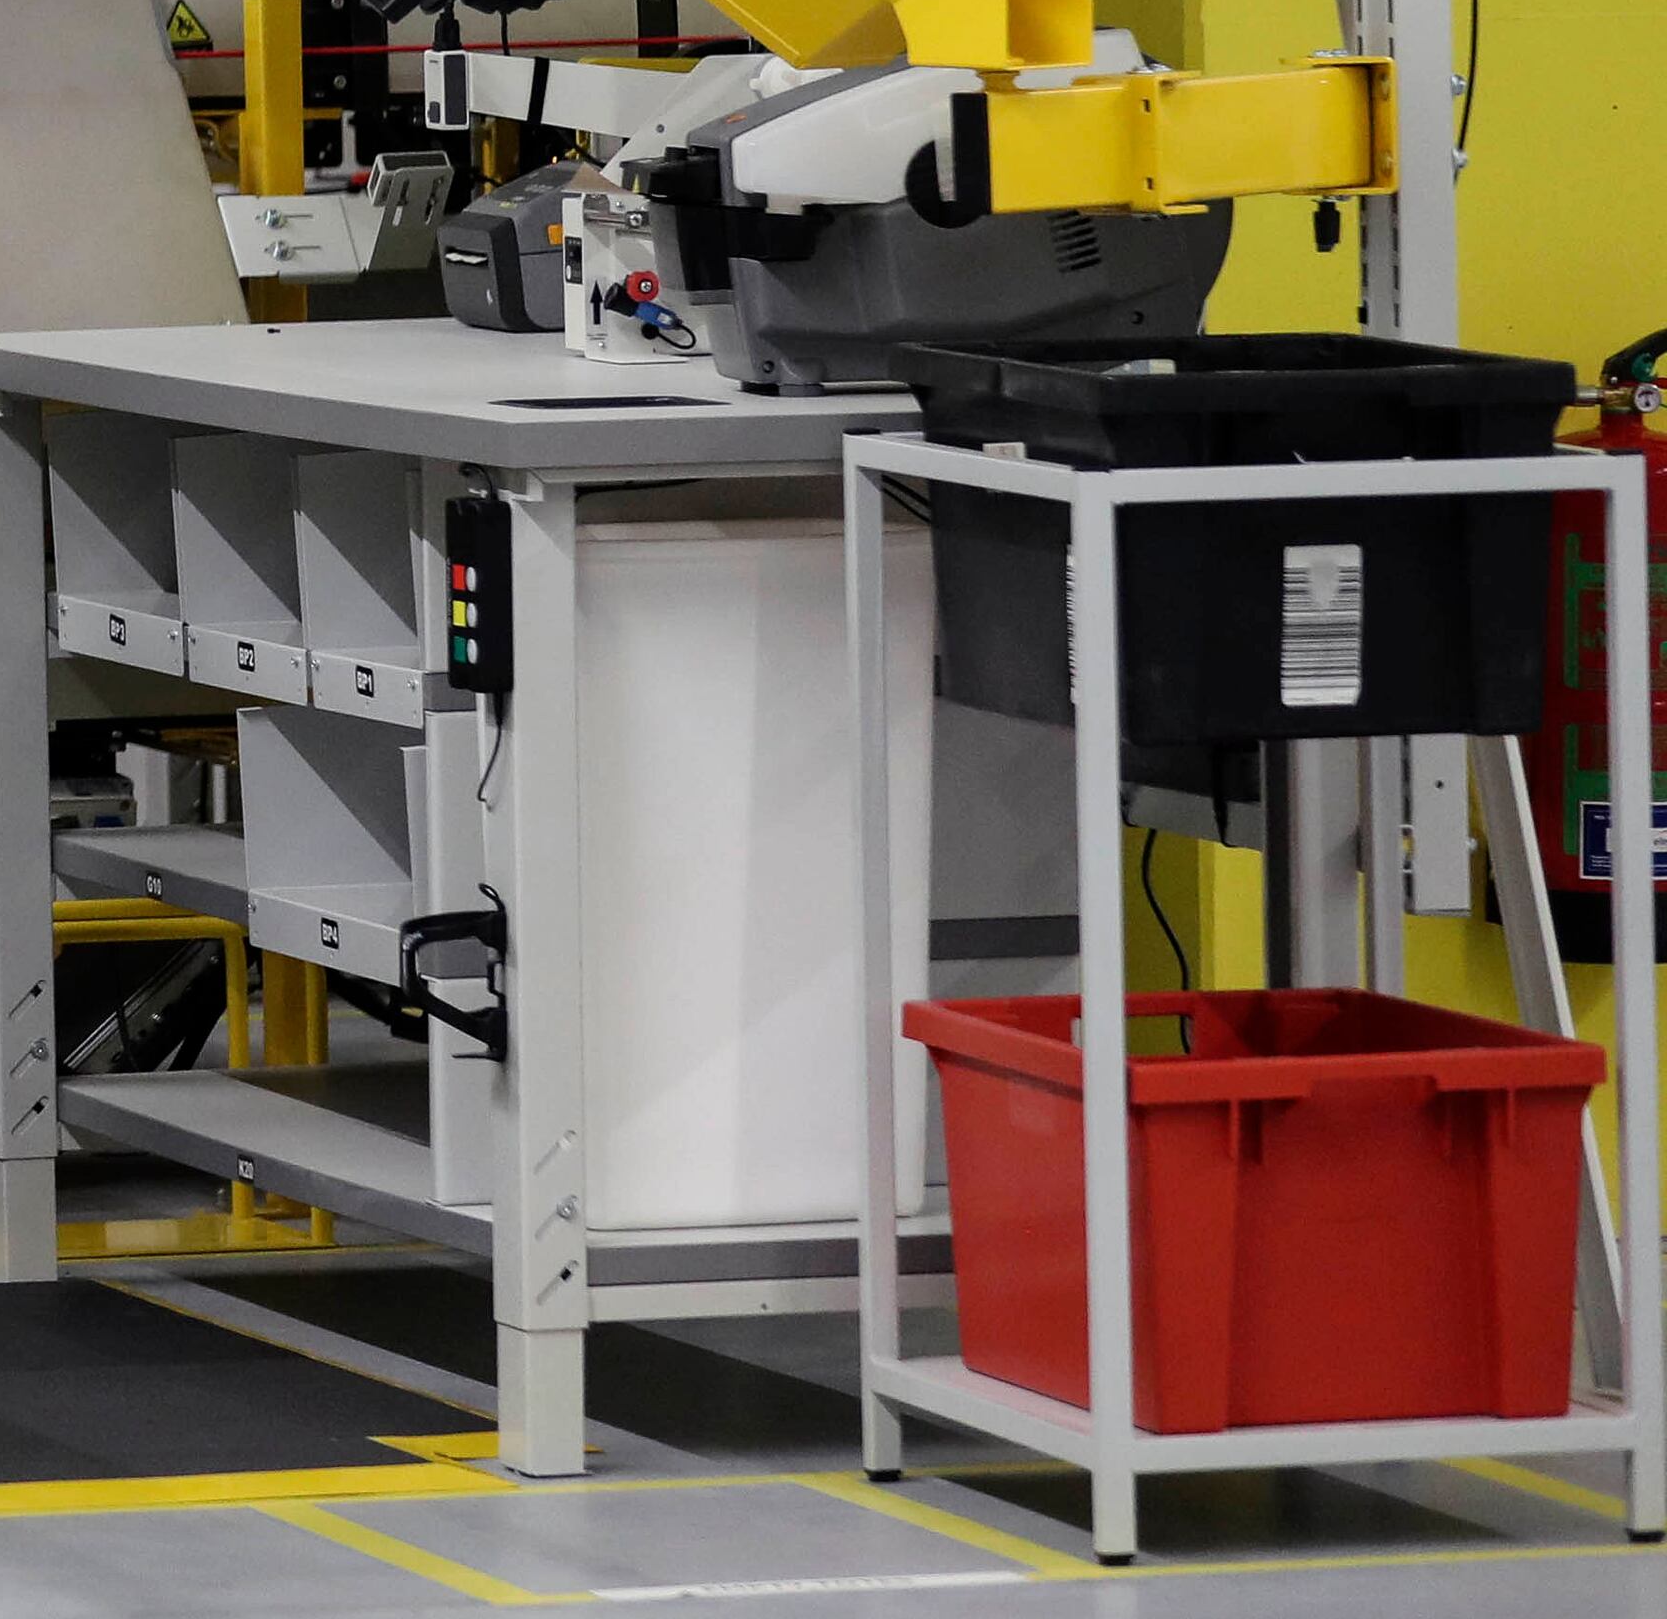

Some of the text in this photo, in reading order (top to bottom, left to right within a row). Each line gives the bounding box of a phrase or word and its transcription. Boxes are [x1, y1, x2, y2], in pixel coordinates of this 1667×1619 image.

[111, 620, 125, 641] BP3
[239, 646, 254, 667] BP2
[357, 671, 373, 693] BP1
